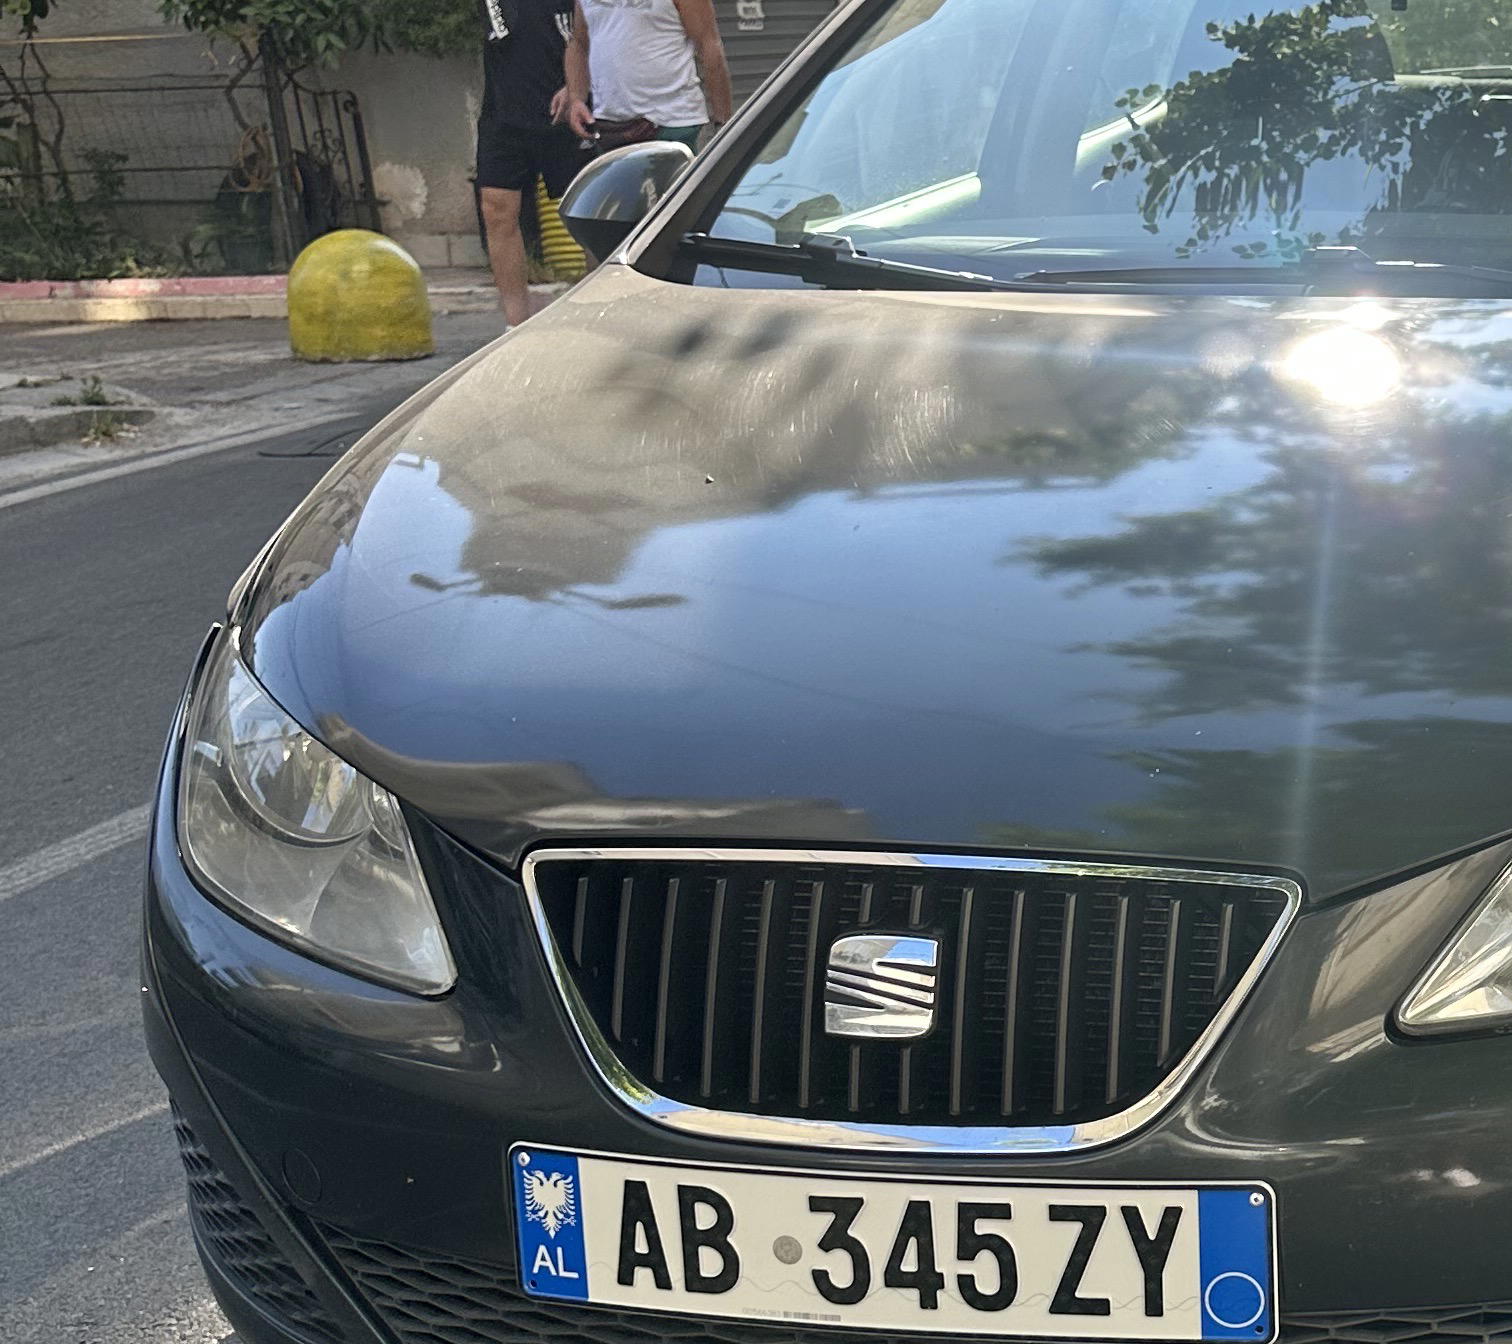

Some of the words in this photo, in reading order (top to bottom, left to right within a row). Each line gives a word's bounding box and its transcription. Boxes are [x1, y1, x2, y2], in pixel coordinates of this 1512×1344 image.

[531, 1244, 580, 1281] AL
[616, 1179, 740, 1294] AB
[808, 1195, 1018, 1313] 345
[1048, 1203, 1182, 1318] ZY
